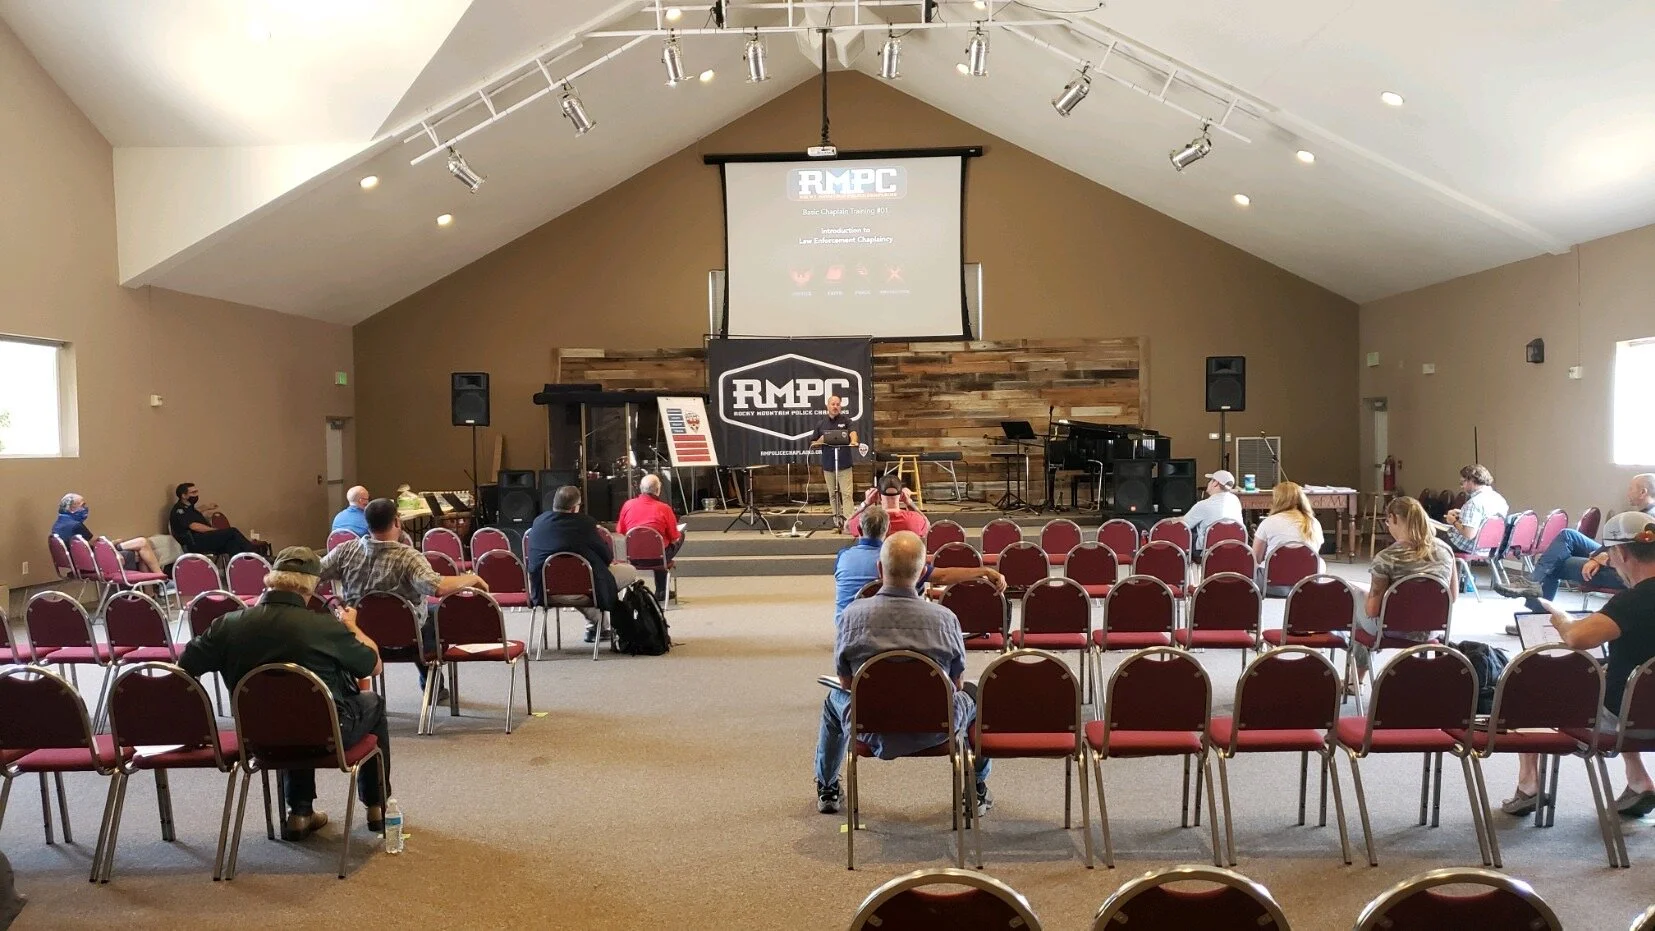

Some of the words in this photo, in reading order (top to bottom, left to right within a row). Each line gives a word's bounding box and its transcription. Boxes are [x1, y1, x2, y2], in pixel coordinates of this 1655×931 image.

[798, 168, 897, 194] RMPC
[802, 208, 820, 216] Basic
[820, 208, 849, 217] Chaplain
[850, 207, 875, 216] Training
[799, 237, 813, 245] Law
[857, 236, 894, 245] Chaplaincy
[732, 378, 850, 409] RMPC
